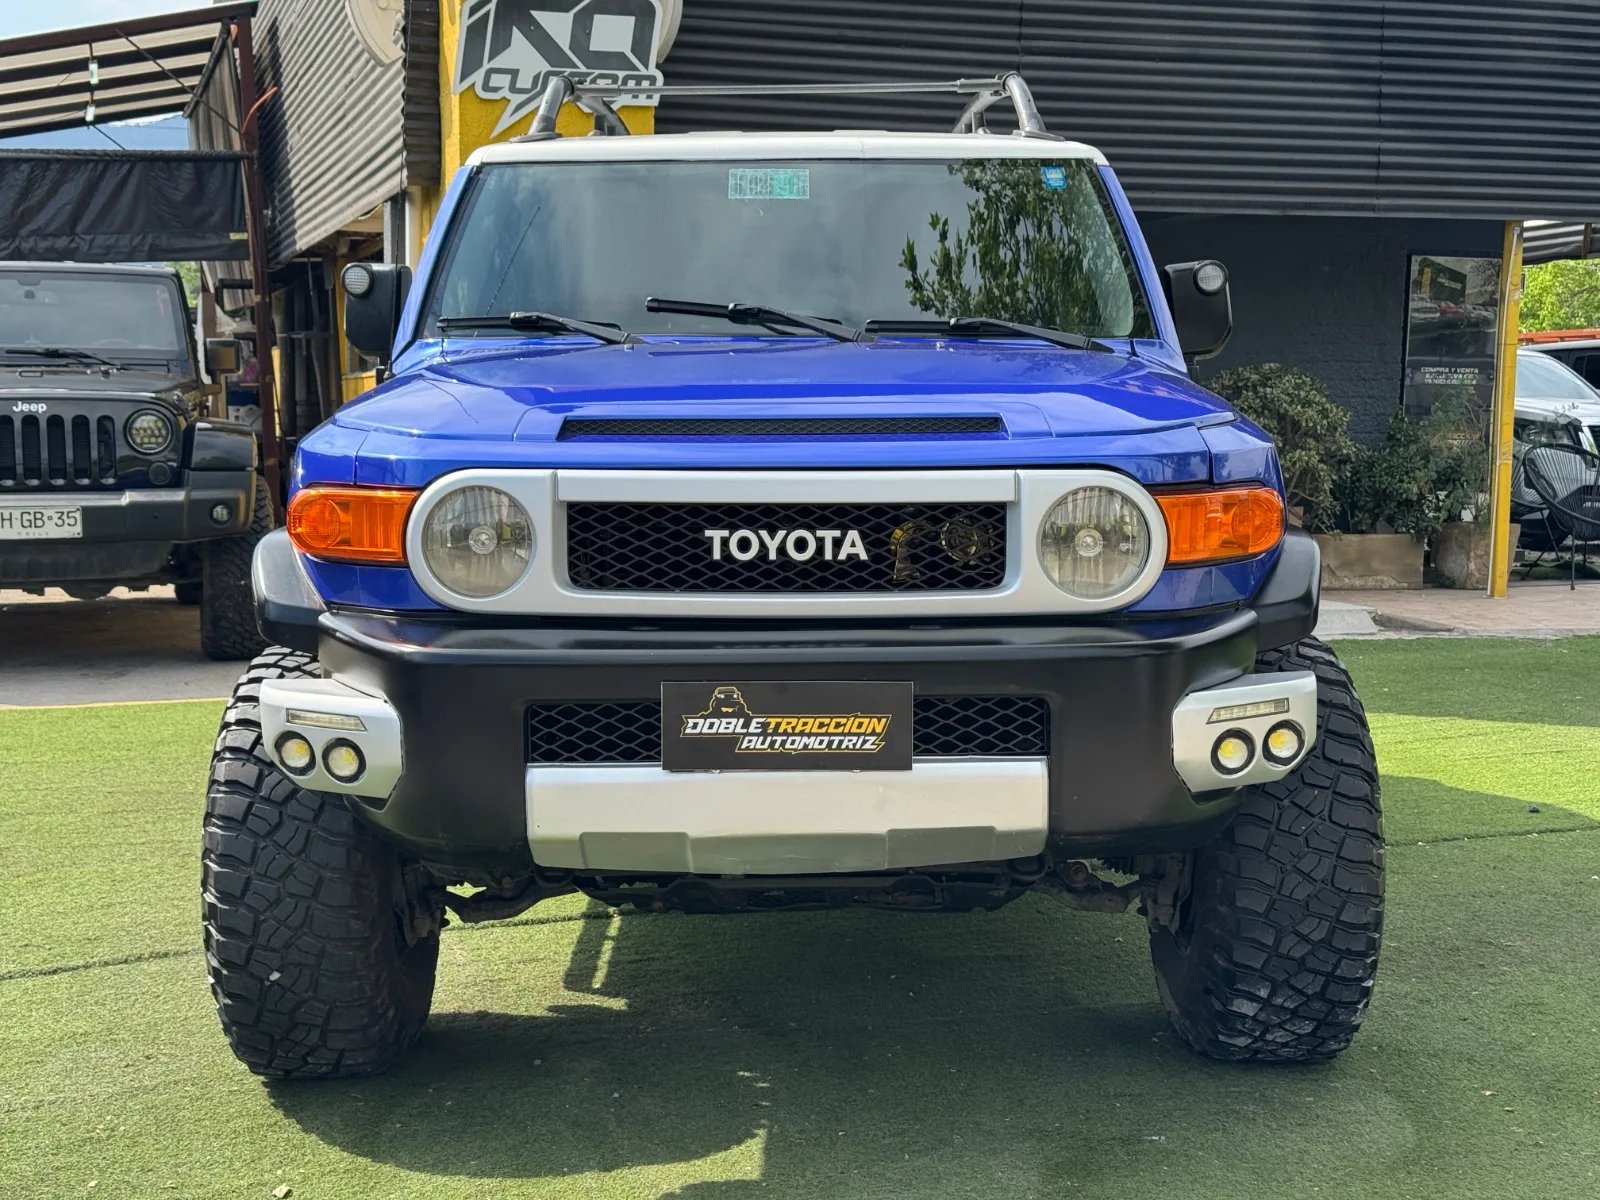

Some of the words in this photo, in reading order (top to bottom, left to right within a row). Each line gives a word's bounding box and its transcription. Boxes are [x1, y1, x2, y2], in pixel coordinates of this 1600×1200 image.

[12, 401, 47, 414] Jeep
[704, 529, 869, 561] TOYOTA
[741, 736, 878, 749] AUTOMOTRIZ
